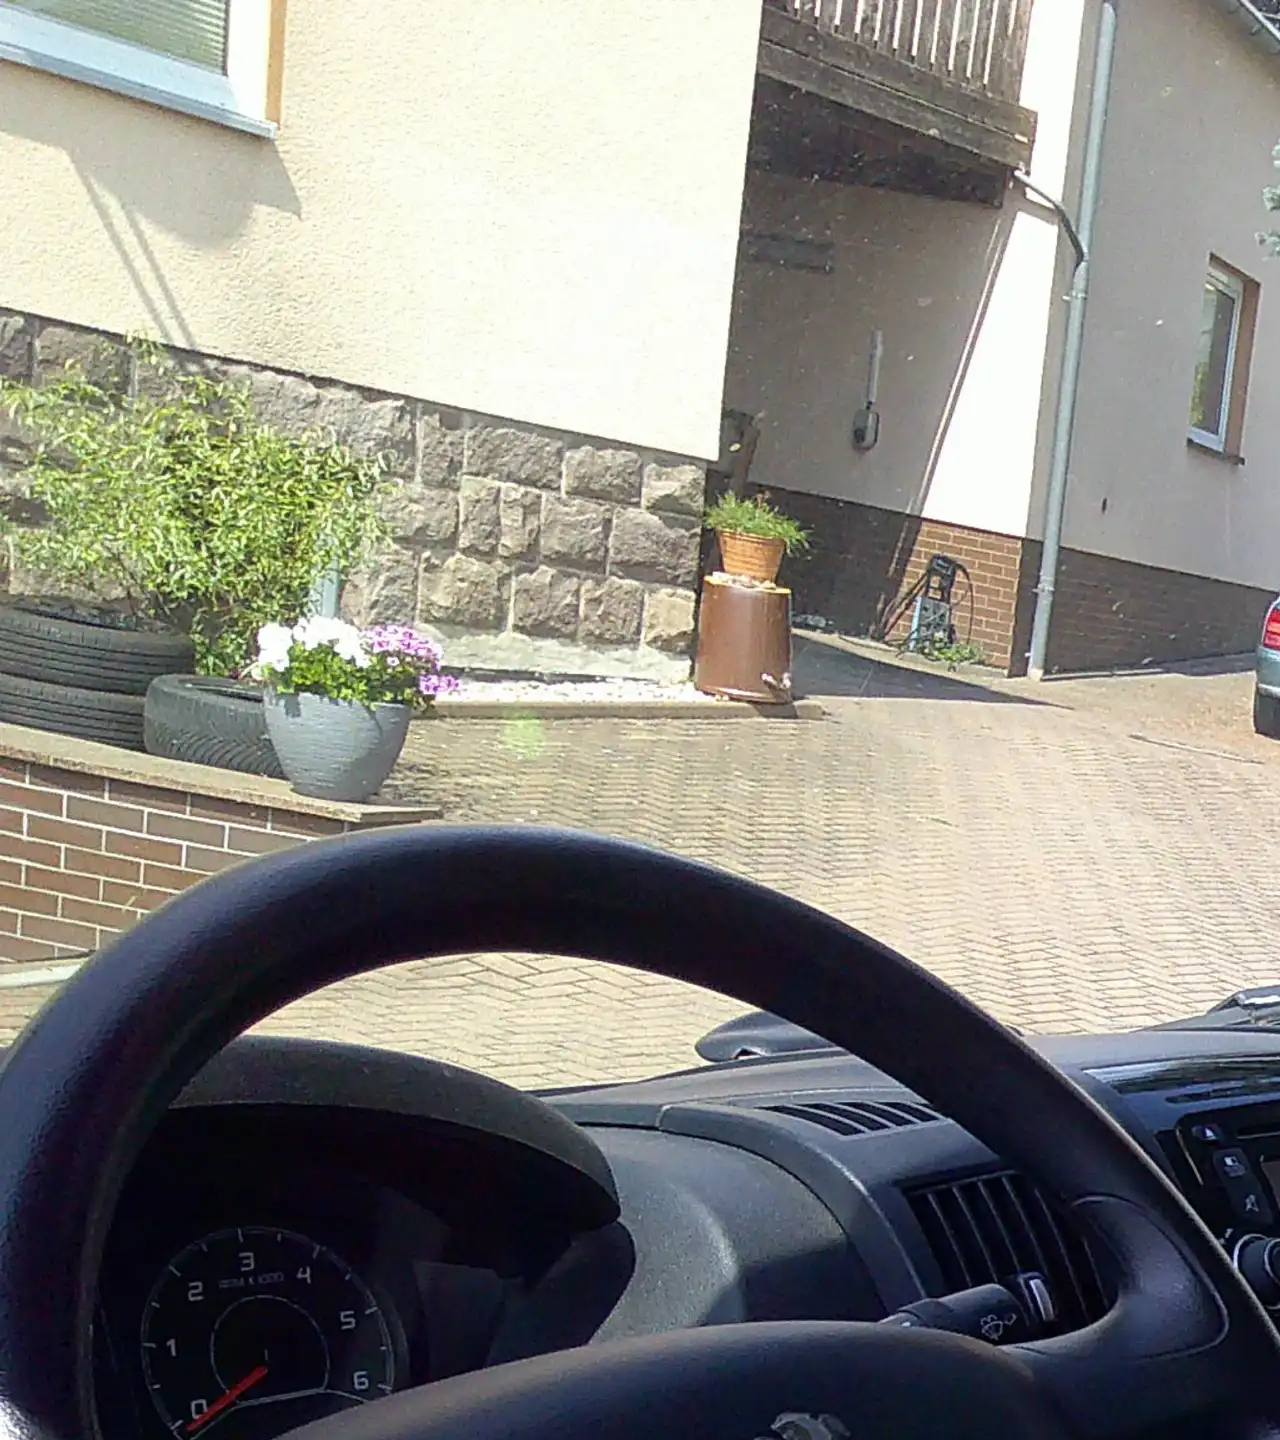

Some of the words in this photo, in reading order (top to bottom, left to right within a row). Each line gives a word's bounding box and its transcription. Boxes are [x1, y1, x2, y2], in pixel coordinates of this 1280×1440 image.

[238, 1251, 254, 1272] 3
[295, 1265, 312, 1284] 4
[187, 1281, 204, 1302] 2
[339, 1309, 357, 1331] 5
[165, 1337, 178, 1358] 1
[352, 1370, 370, 1390] 6
